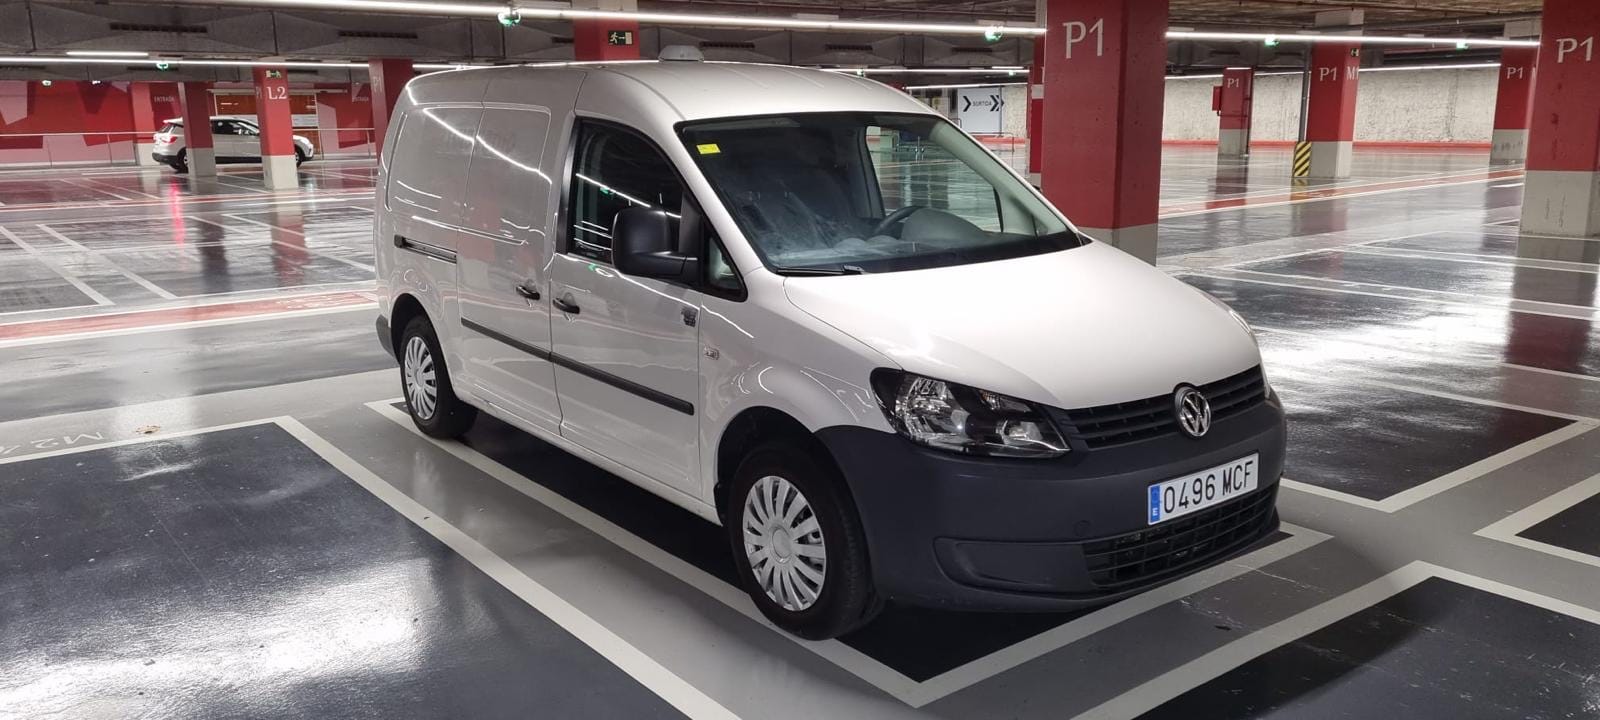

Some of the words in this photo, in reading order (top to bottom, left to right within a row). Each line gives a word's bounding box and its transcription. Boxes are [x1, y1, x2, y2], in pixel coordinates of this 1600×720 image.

[1063, 18, 1104, 59] P1
[1556, 36, 1593, 63] P1
[1319, 66, 1337, 81] P1
[1507, 66, 1523, 79] P1
[1227, 77, 1240, 88] P1
[266, 86, 288, 100] L2
[1152, 507, 1159, 516] E
[1164, 474, 1216, 514] 0496
[1222, 460, 1254, 496] MCF
